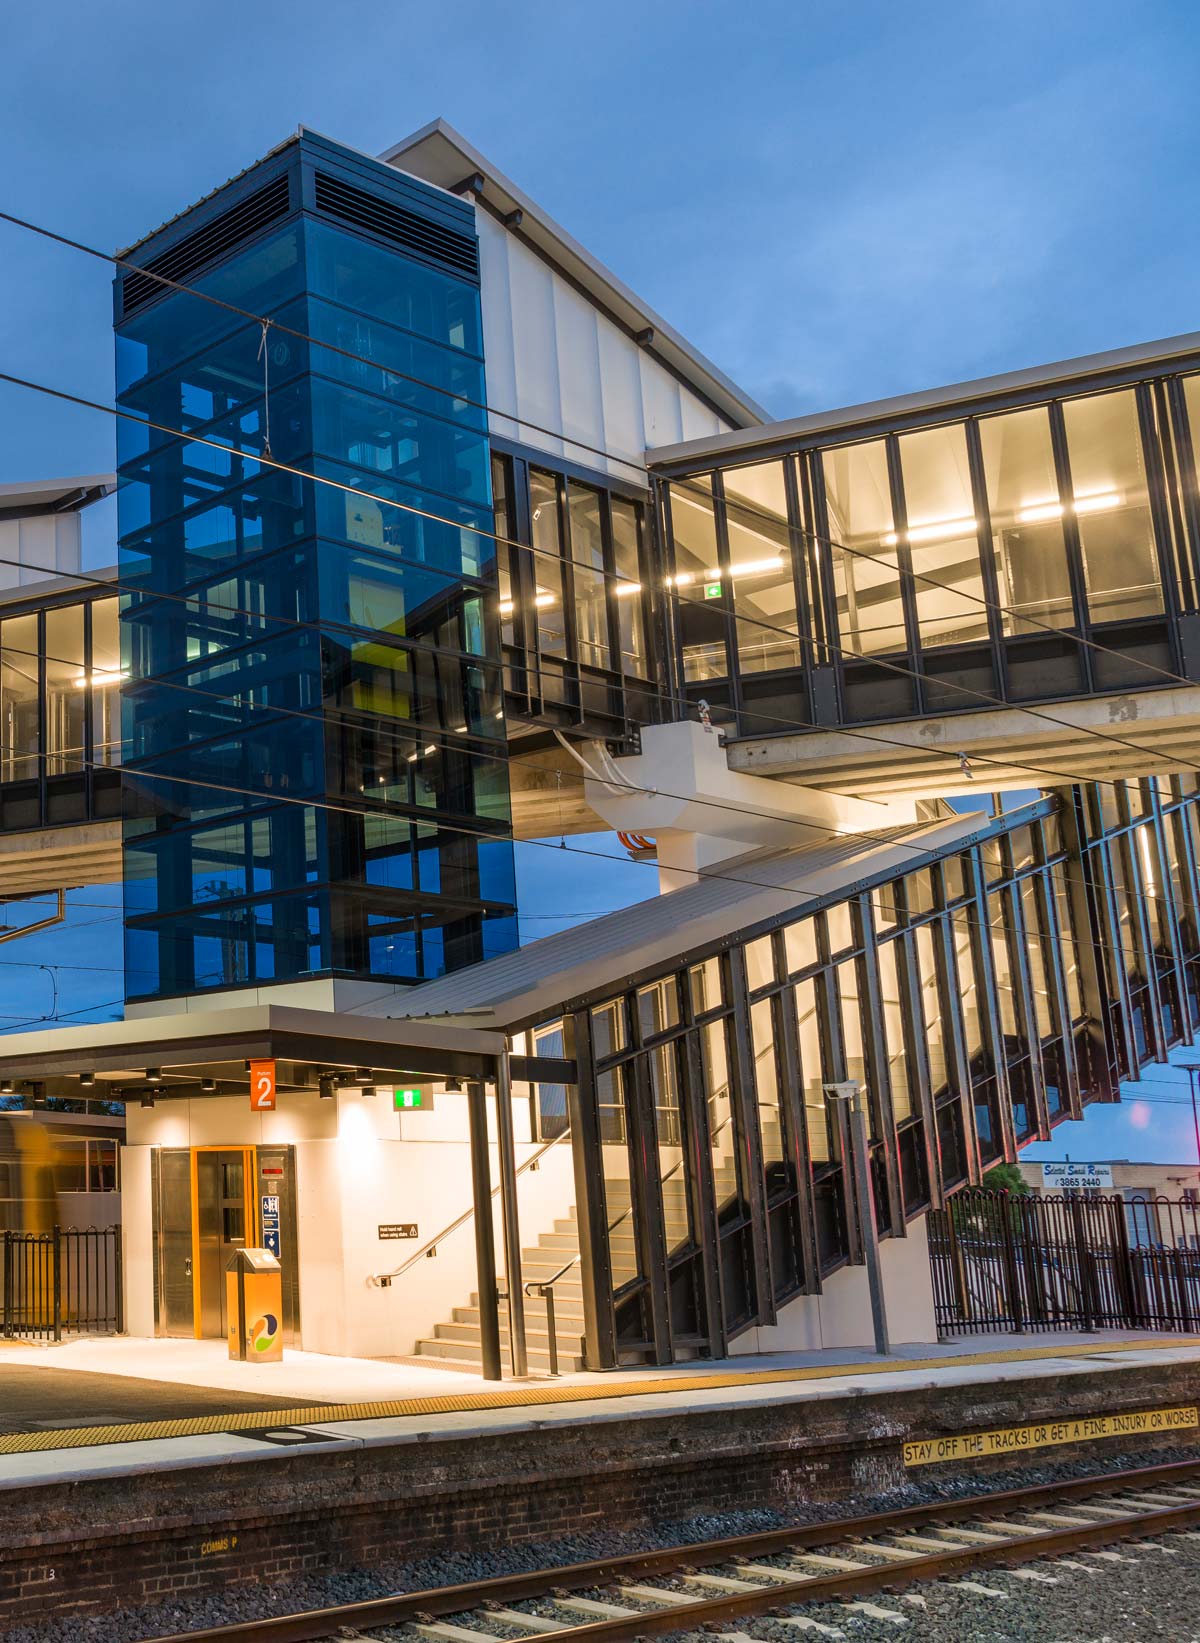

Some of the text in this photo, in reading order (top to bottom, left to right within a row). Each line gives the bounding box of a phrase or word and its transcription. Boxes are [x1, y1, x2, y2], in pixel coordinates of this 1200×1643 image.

[257, 1077, 271, 1106] 2
[1081, 1178, 1101, 1186] 2440
[905, 1443, 932, 1462] STAY
[937, 1439, 958, 1456] OFF
[962, 1435, 983, 1452] THE
[988, 1429, 1031, 1449] TRACKS!
[1034, 1427, 1047, 1442] OR
[1051, 1424, 1069, 1440] GET
[1073, 1423, 1080, 1437] A
[1112, 1414, 1147, 1432] INJURY
[1150, 1413, 1162, 1428] OR
[201, 1535, 238, 1554] COMMS P
[49, 1568, 55, 1580] 3
